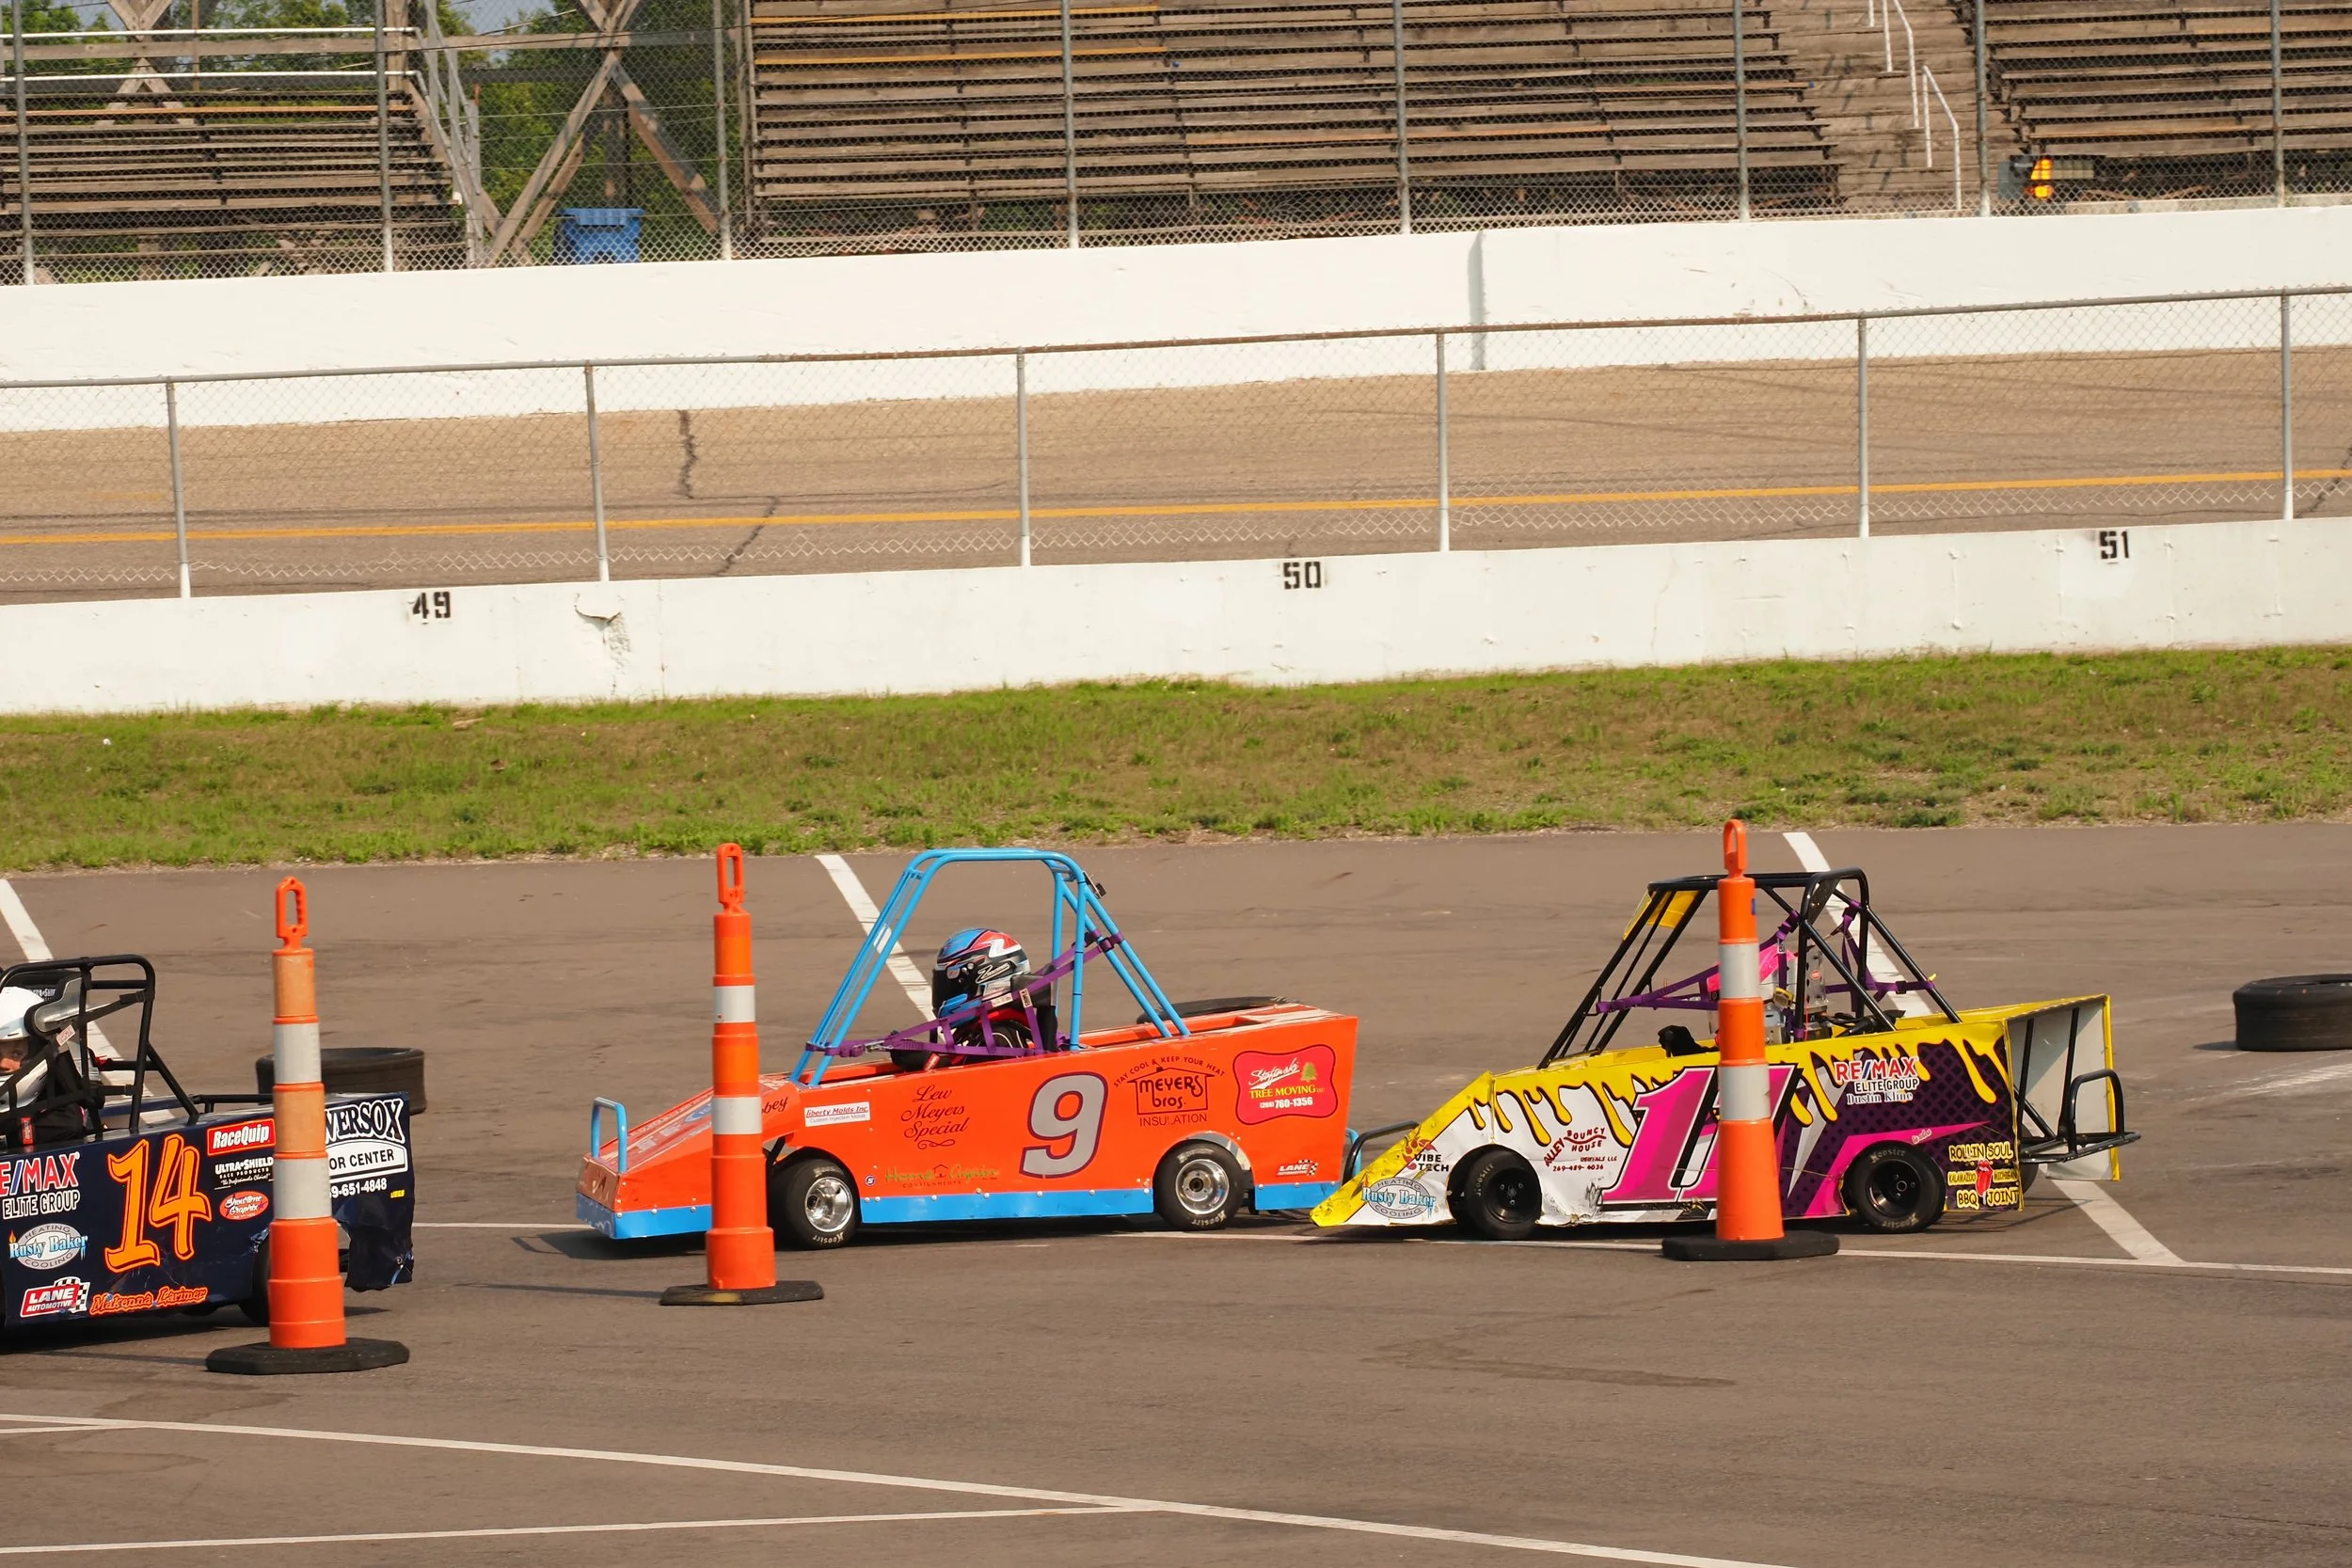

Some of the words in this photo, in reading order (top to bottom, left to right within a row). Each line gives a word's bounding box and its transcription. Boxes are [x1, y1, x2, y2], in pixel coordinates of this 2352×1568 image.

[2100, 531, 2129, 559] 51
[1283, 562, 1321, 590] 50
[412, 592, 451, 619] 49
[1114, 1072, 1129, 1087] STAY
[1130, 1061, 1149, 1074] COOL
[1184, 1056, 1203, 1067] YOUR
[1206, 1063, 1225, 1077] HEAT
[1834, 1057, 1917, 1082] RE/MAX
[913, 1085, 952, 1101] Lew
[1249, 1088, 1273, 1099] TREE
[1275, 1085, 1315, 1097] MOVING
[1855, 1081, 1884, 1093] ELITE
[1885, 1078, 1919, 1091] GROUP
[1847, 1093, 1882, 1105] Dustin
[1884, 1091, 1913, 1102] Kline
[900, 1102, 964, 1123] Meyers
[904, 1117, 970, 1142] Special
[1019, 1071, 1108, 1179] 9
[1566, 1127, 1605, 1140] BOUNCY
[213, 1124, 270, 1149] RaceQuip
[1571, 1140, 1602, 1152] HOUSE
[349, 1148, 394, 1166] CENTER
[1414, 1153, 1441, 1163] VIBE
[1543, 1138, 1565, 1166] ALLEY
[1948, 1144, 1985, 1162] ROLLIN
[1987, 1141, 2013, 1160] SOUL
[0, 1153, 80, 1196] E/MAX
[1418, 1163, 1449, 1172] TECH
[1377, 1178, 1422, 1190] HEATING
[3, 1195, 39, 1219] ELITE
[40, 1190, 80, 1214] GROUP
[104, 1133, 212, 1274] 14
[1362, 1186, 1396, 1207] Rusty
[1399, 1189, 1436, 1207] Baker
[1957, 1190, 1979, 1210] BBQ
[1987, 1187, 2018, 1206] JOINT
[1375, 1205, 1422, 1217] COOLING
[25, 1225, 71, 1240] HEATING
[9, 1242, 46, 1259] Rusty
[49, 1233, 88, 1253] Baker
[25, 1253, 73, 1268] COOLING
[26, 1300, 73, 1312] AUTOMOTIVE
[29, 1287, 75, 1304] LANE
[90, 1292, 154, 1315] Makenna
[156, 1286, 208, 1307] Larimer
